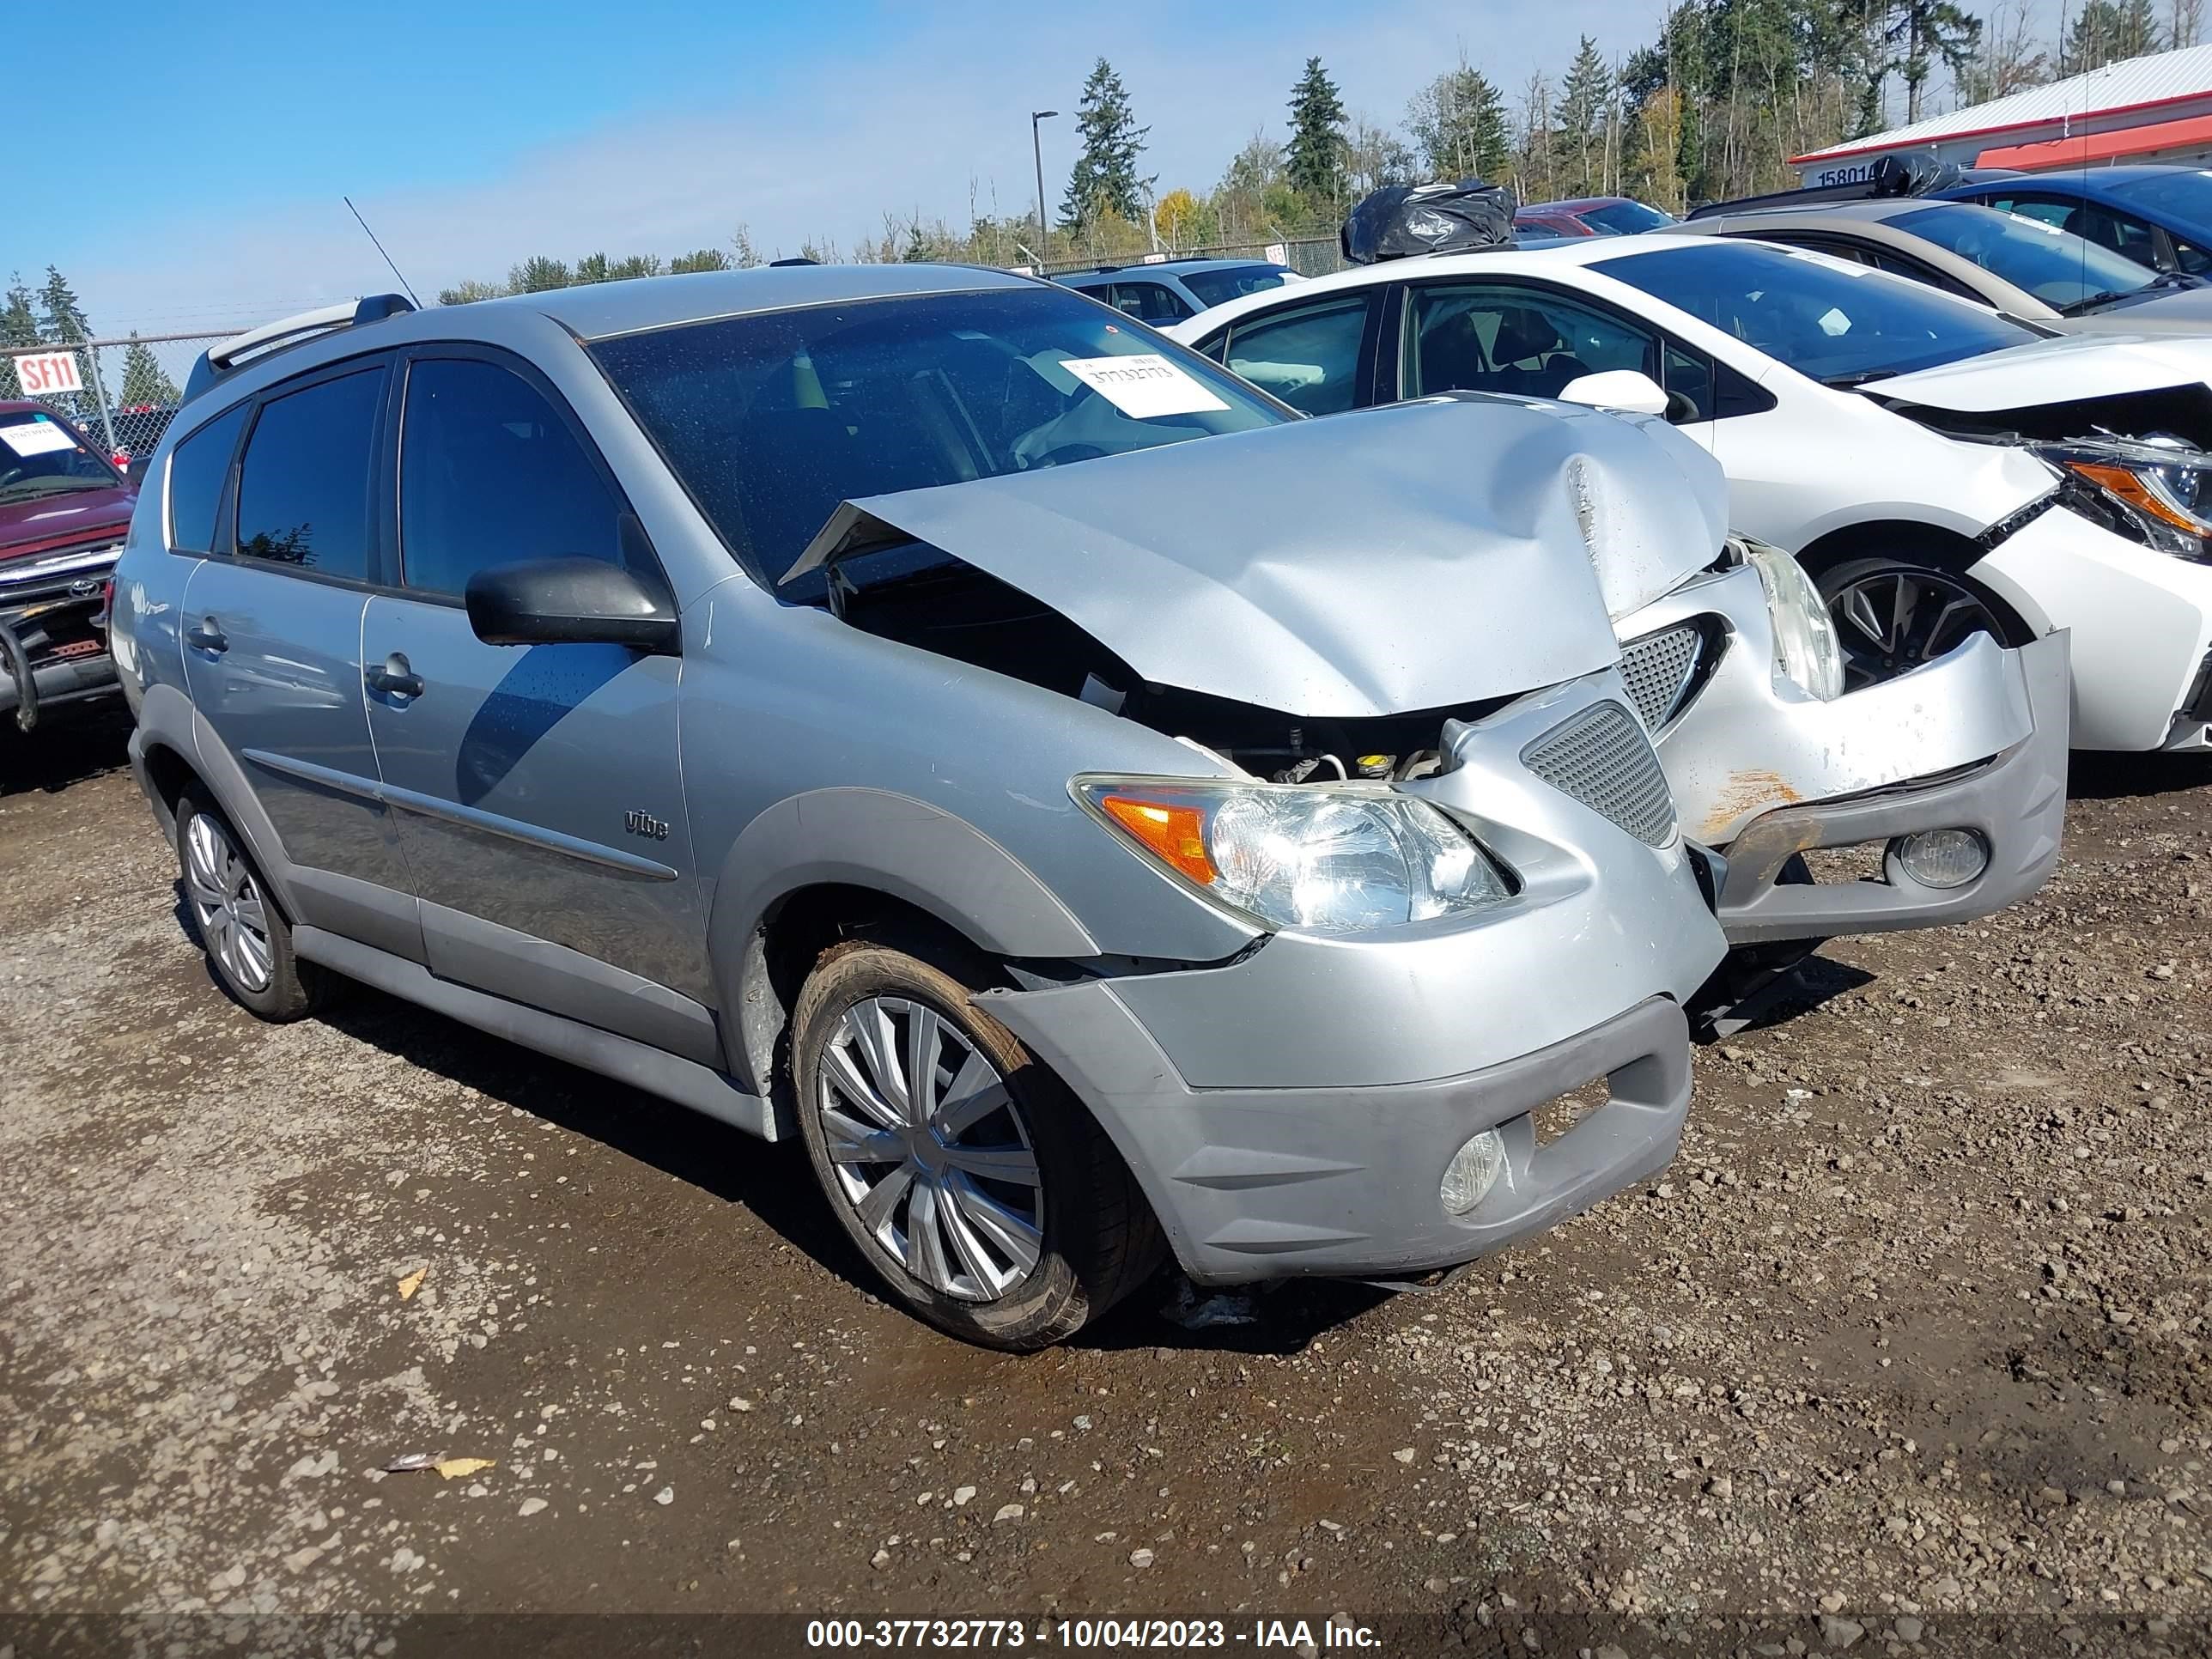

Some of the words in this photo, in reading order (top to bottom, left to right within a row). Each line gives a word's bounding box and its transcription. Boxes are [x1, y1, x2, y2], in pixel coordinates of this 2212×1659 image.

[21, 356, 74, 390] SF11
[1088, 367, 1173, 383] 37732773
[625, 810, 669, 839] vibe
